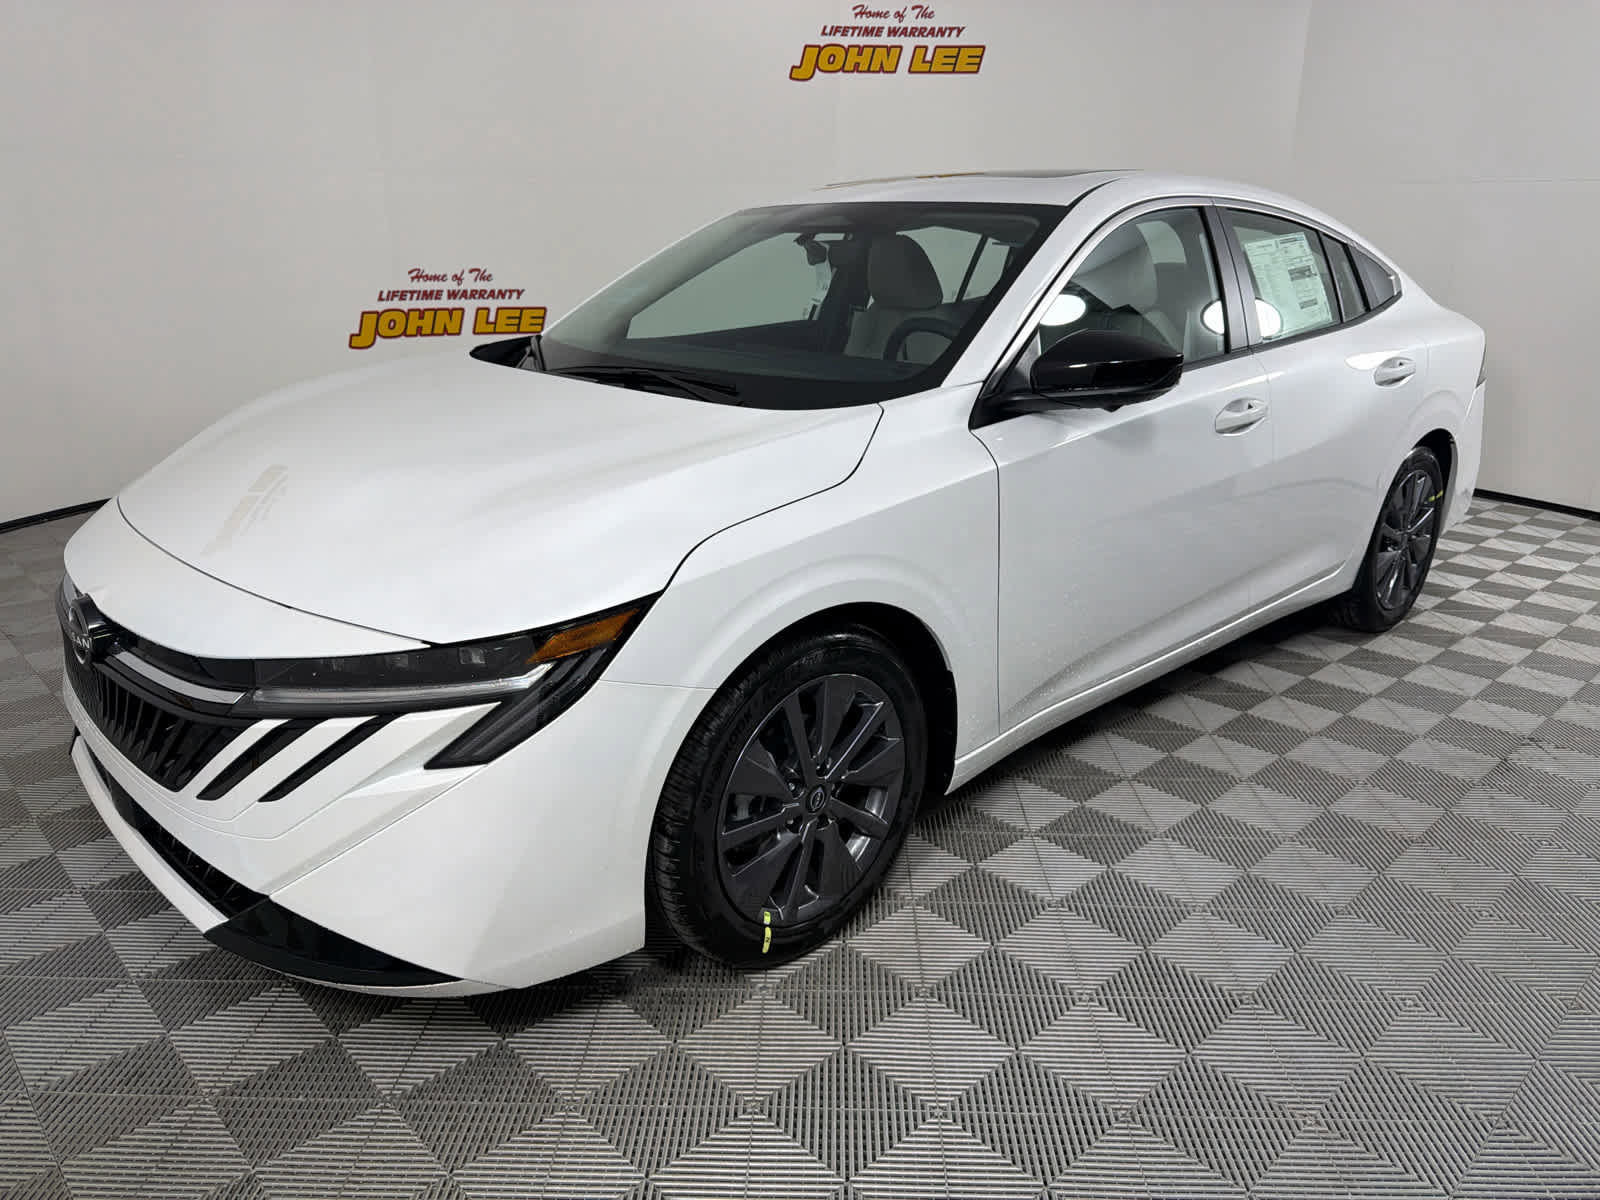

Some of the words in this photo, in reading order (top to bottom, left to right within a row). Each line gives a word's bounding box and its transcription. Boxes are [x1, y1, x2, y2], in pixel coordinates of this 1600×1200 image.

[852, 4, 890, 19] Home
[893, 6, 908, 23] of
[911, 4, 935, 19] The
[821, 25, 885, 37] LIFETIME
[886, 26, 966, 38] WARRANTY
[789, 44, 903, 81] JOHN
[908, 45, 986, 74] LEE
[407, 268, 448, 283] Home
[451, 269, 464, 286] of
[468, 268, 493, 283] The
[377, 289, 444, 302] LIFETIME
[446, 288, 525, 301] WARRANTY
[349, 307, 465, 350] JOHN
[472, 306, 547, 335] LEE
